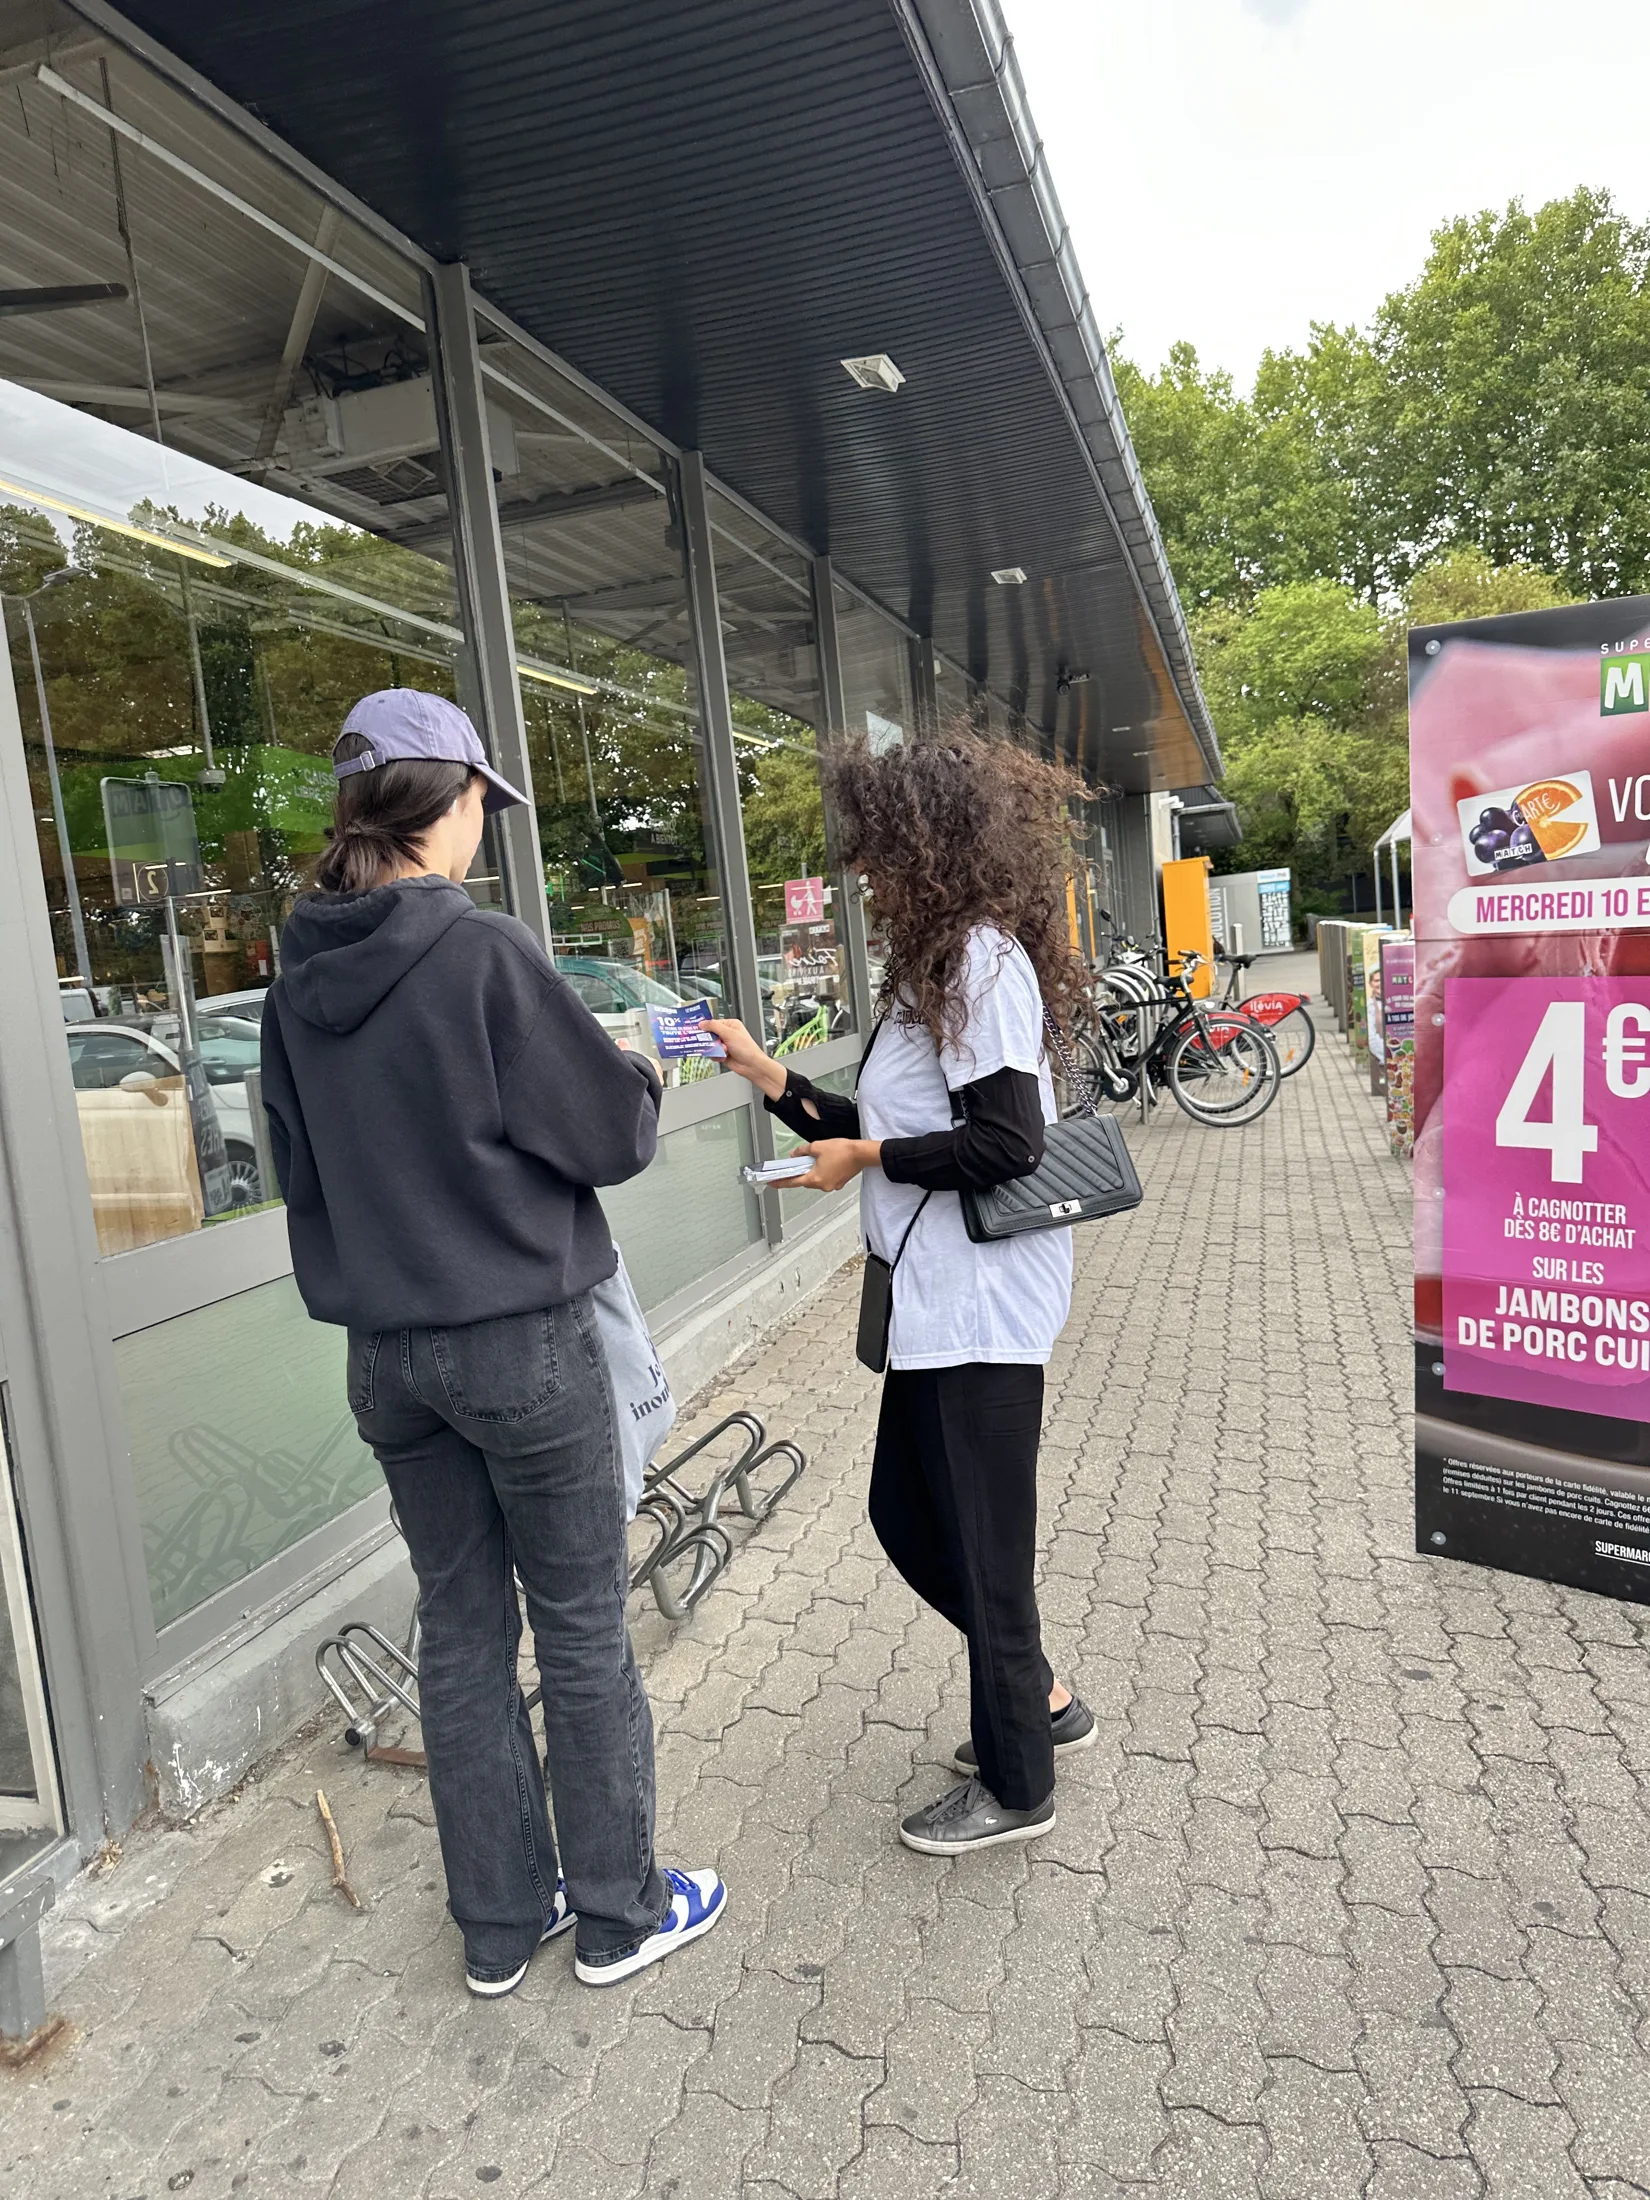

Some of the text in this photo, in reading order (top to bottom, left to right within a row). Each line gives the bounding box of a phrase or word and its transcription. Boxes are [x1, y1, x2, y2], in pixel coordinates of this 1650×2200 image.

[1494, 843, 1532, 860] MATCH
[1476, 890, 1593, 923] MERCREDI
[1601, 889, 1628, 917] 10
[1513, 1191, 1626, 1225] À CAGNOTTER
[1504, 1215, 1636, 1249] DÈS 8€ D'ACHAT
[1532, 1256, 1604, 1285] SUR LES
[1495, 1285, 1650, 1333] JAMBONS
[1458, 1316, 1650, 1371] DE PORC CUI
[1442, 1467, 1471, 1478] (remises
[1471, 1472, 1502, 1484] déduites)
[1515, 1480, 1525, 1489] les
[1526, 1483, 1555, 1494] jambons
[1556, 1489, 1566, 1497] de
[1566, 1491, 1583, 1500] porc
[1604, 1498, 1641, 1511] Cagnottez
[1442, 1476, 1463, 1487] Offres
[1463, 1480, 1490, 1491] limitées
[1502, 1487, 1515, 1496] fois
[1516, 1491, 1527, 1499] par
[1528, 1493, 1547, 1503] client
[1548, 1498, 1577, 1509] pendant
[1577, 1503, 1588, 1511] les
[1596, 1507, 1616, 1517] jours.
[1617, 1510, 1632, 1520] Ces
[1447, 1458, 1468, 1468] Offres
[1469, 1462, 1501, 1474] réservées
[1502, 1469, 1514, 1477] aux
[1515, 1471, 1544, 1483] porteurs
[1544, 1476, 1554, 1484] de
[1555, 1478, 1561, 1486] la
[1563, 1480, 1581, 1490] carte
[1610, 1490, 1636, 1500] valable
[1638, 1493, 1645, 1502] le
[1442, 1486, 1450, 1494] le
[1451, 1487, 1459, 1495] 11
[1460, 1490, 1496, 1502] septembre
[1504, 1499, 1520, 1508] vous
[1521, 1502, 1543, 1512] n'avez
[1544, 1506, 1557, 1515] pas
[1558, 1509, 1582, 1520] encore
[1583, 1514, 1593, 1522] de
[1594, 1517, 1613, 1527] carte
[1614, 1521, 1624, 1529] de
[1625, 1522, 1650, 1534] fidélité
[1595, 1540, 1650, 1563] SUPERMAR
